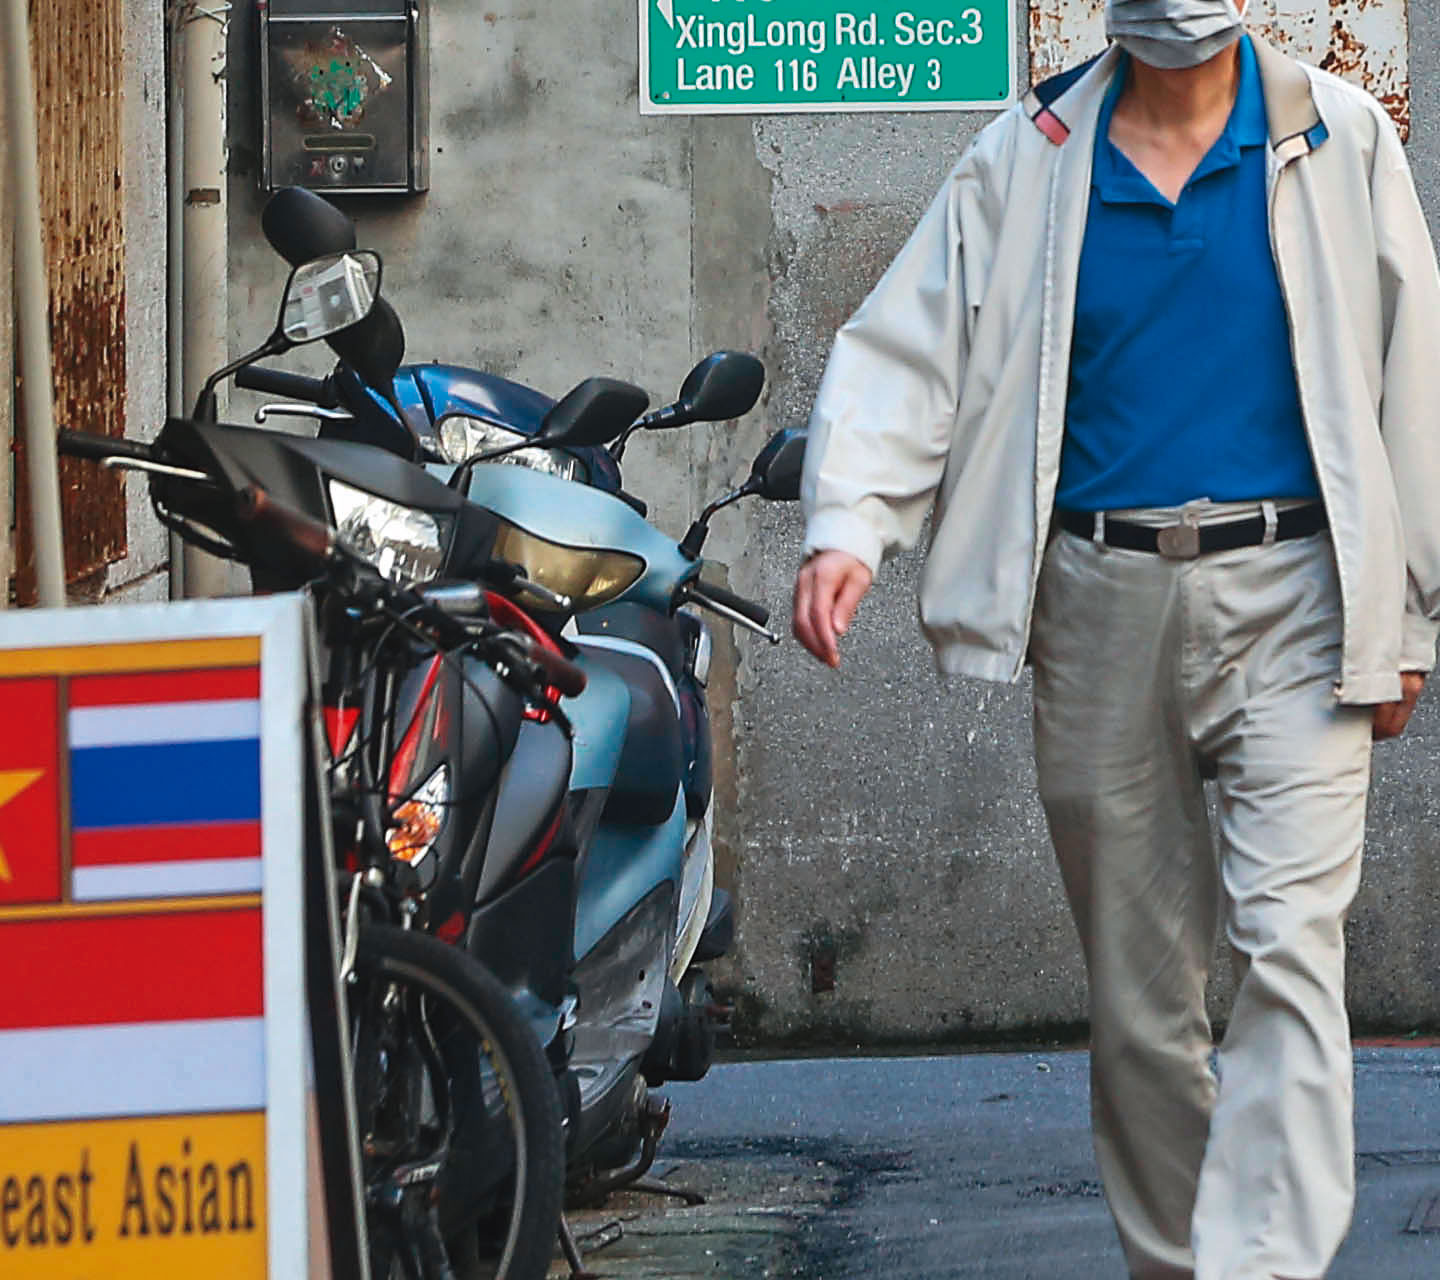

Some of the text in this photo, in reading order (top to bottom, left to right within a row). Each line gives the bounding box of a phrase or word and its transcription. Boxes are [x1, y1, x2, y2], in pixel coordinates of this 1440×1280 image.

[674, 8, 985, 55] XingLong Rd. Sec.3
[676, 55, 942, 97] Lane 116 Alley 3
[118, 1137, 256, 1241] Asian
